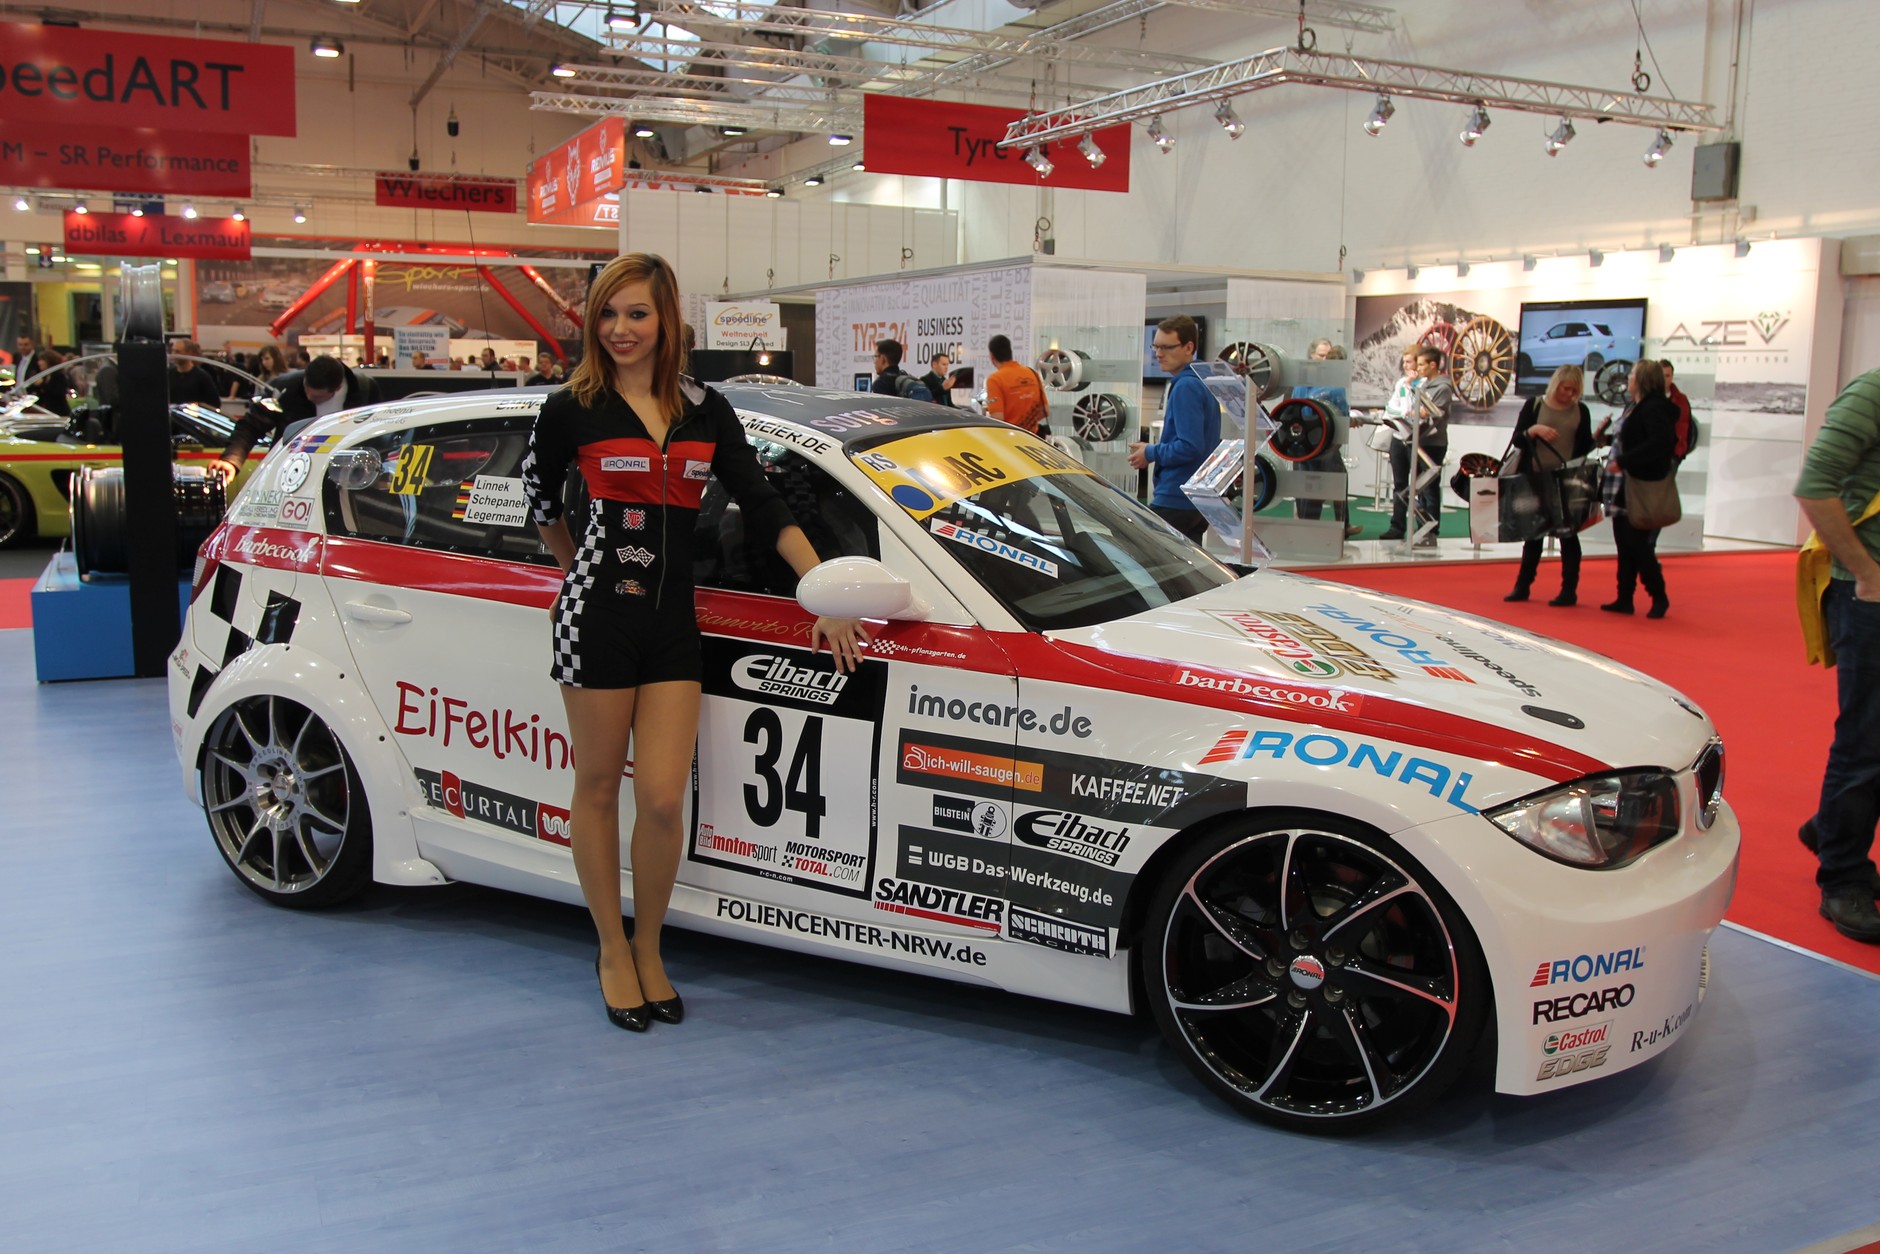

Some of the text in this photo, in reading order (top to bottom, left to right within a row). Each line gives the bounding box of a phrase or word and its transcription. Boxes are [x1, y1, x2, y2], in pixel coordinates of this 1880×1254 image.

[0, 142, 23, 162] M
[60, 144, 89, 165] SR
[97, 148, 239, 173] Performance
[948, 127, 1008, 166] Tyre
[384, 178, 504, 205] Wiechers
[68, 224, 127, 244] dbilas
[161, 227, 244, 248] Lexmaul
[720, 313, 768, 324] speedline
[917, 317, 963, 336] BUSINESS
[716, 340, 738, 348] Design
[721, 330, 768, 338] Weltneuheit
[852, 322, 886, 351] TYRE
[917, 342, 962, 365] LOUNGE
[393, 446, 432, 493] 34
[609, 459, 646, 469] RONAL
[861, 453, 897, 471] RS
[904, 451, 1006, 500] ADAC
[476, 479, 509, 492] Linnek
[282, 500, 311, 521] GO!
[471, 494, 528, 509] Schepanek
[467, 510, 524, 523] Legermann
[628, 514, 641, 524] VIP
[233, 536, 320, 564] barbecook
[955, 529, 1053, 574] RONAL
[1306, 603, 1449, 665] RONAL
[895, 645, 967, 660] 24h-pflanzgarten.de
[1436, 633, 1542, 698] speedline
[731, 655, 848, 692] Eibach
[758, 682, 831, 702] SPRINGS
[1176, 670, 1350, 713] barbecook
[395, 681, 576, 770] EiFelkin
[909, 685, 1092, 739] imocare.de
[743, 707, 826, 839] 34
[927, 754, 1040, 786] ich-will-saugen.de
[1243, 731, 1480, 816] RONAL
[419, 779, 533, 830] SECURTAL
[1071, 774, 1184, 808] KAFFEE.NET
[934, 806, 970, 821] BILSTEIN
[1014, 810, 1130, 854] Eibach
[785, 841, 866, 868] MOTORSPORT
[928, 851, 969, 871] WGB
[1047, 838, 1114, 864] SPRINGS
[760, 870, 793, 882] r-c-n.com
[794, 857, 860, 882] TOTAL.COM
[875, 878, 1004, 923] SANDTLER
[717, 898, 987, 966] FOLIENCENTER-NRW.de
[1011, 913, 1106, 951] SCHROTH
[1295, 968, 1322, 980] RONAL
[1550, 947, 1644, 984] RONAL
[1532, 984, 1635, 1025] RECARO
[1559, 1025, 1608, 1051] Castrol
[1631, 1004, 1692, 1052] R-u-K.com
[1536, 1045, 1612, 1082] EDGE
